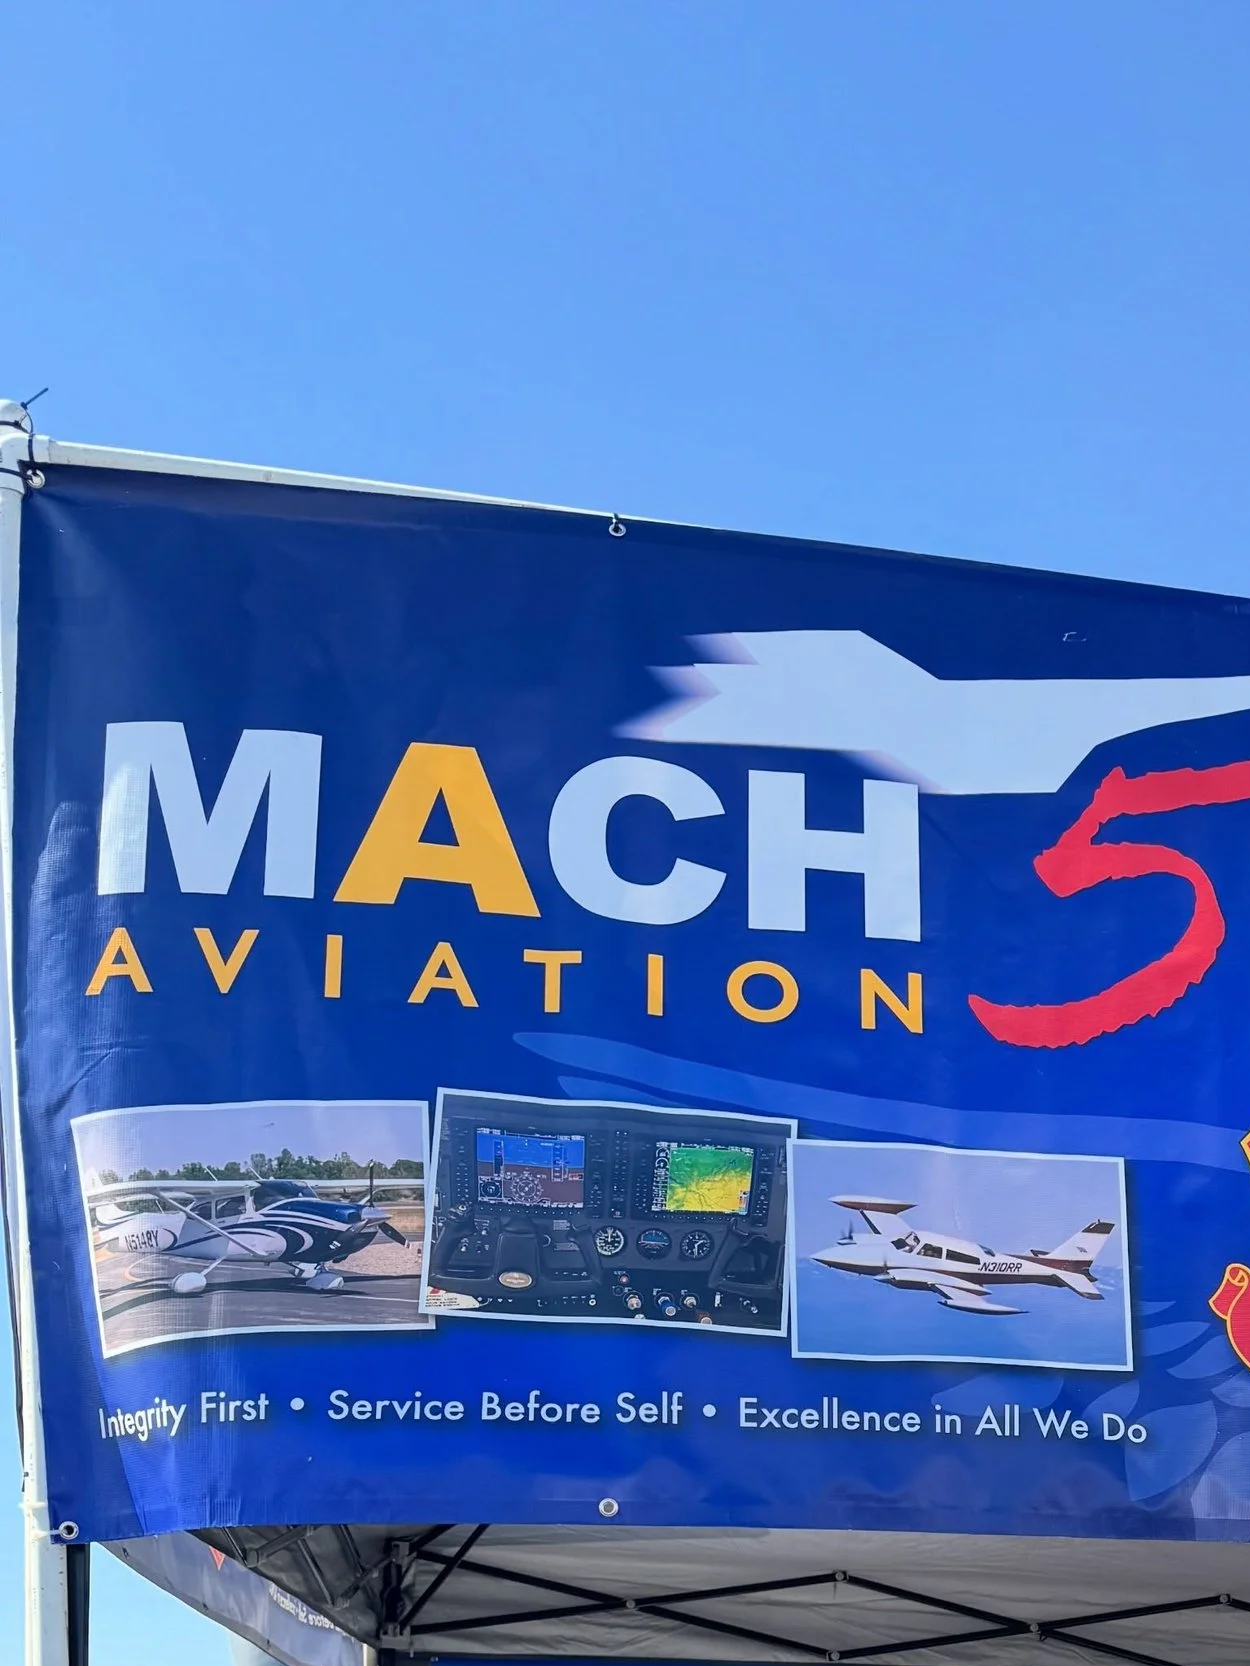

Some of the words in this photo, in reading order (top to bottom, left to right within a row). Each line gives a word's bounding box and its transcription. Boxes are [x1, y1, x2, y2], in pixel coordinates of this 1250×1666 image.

[97, 719, 921, 942] MACH
[85, 926, 925, 1035] AVIATION
[981, 1261, 1022, 1274] N310RR
[98, 1396, 187, 1442] Integrity
[200, 1391, 269, 1423] First
[327, 1389, 465, 1421] Service
[481, 1390, 601, 1423] Before
[616, 1391, 683, 1425] Self
[739, 1396, 921, 1432] Excellence
[935, 1404, 962, 1435] in
[974, 1404, 1020, 1436] All
[1033, 1408, 1089, 1439] We
[1102, 1413, 1147, 1443] Do
